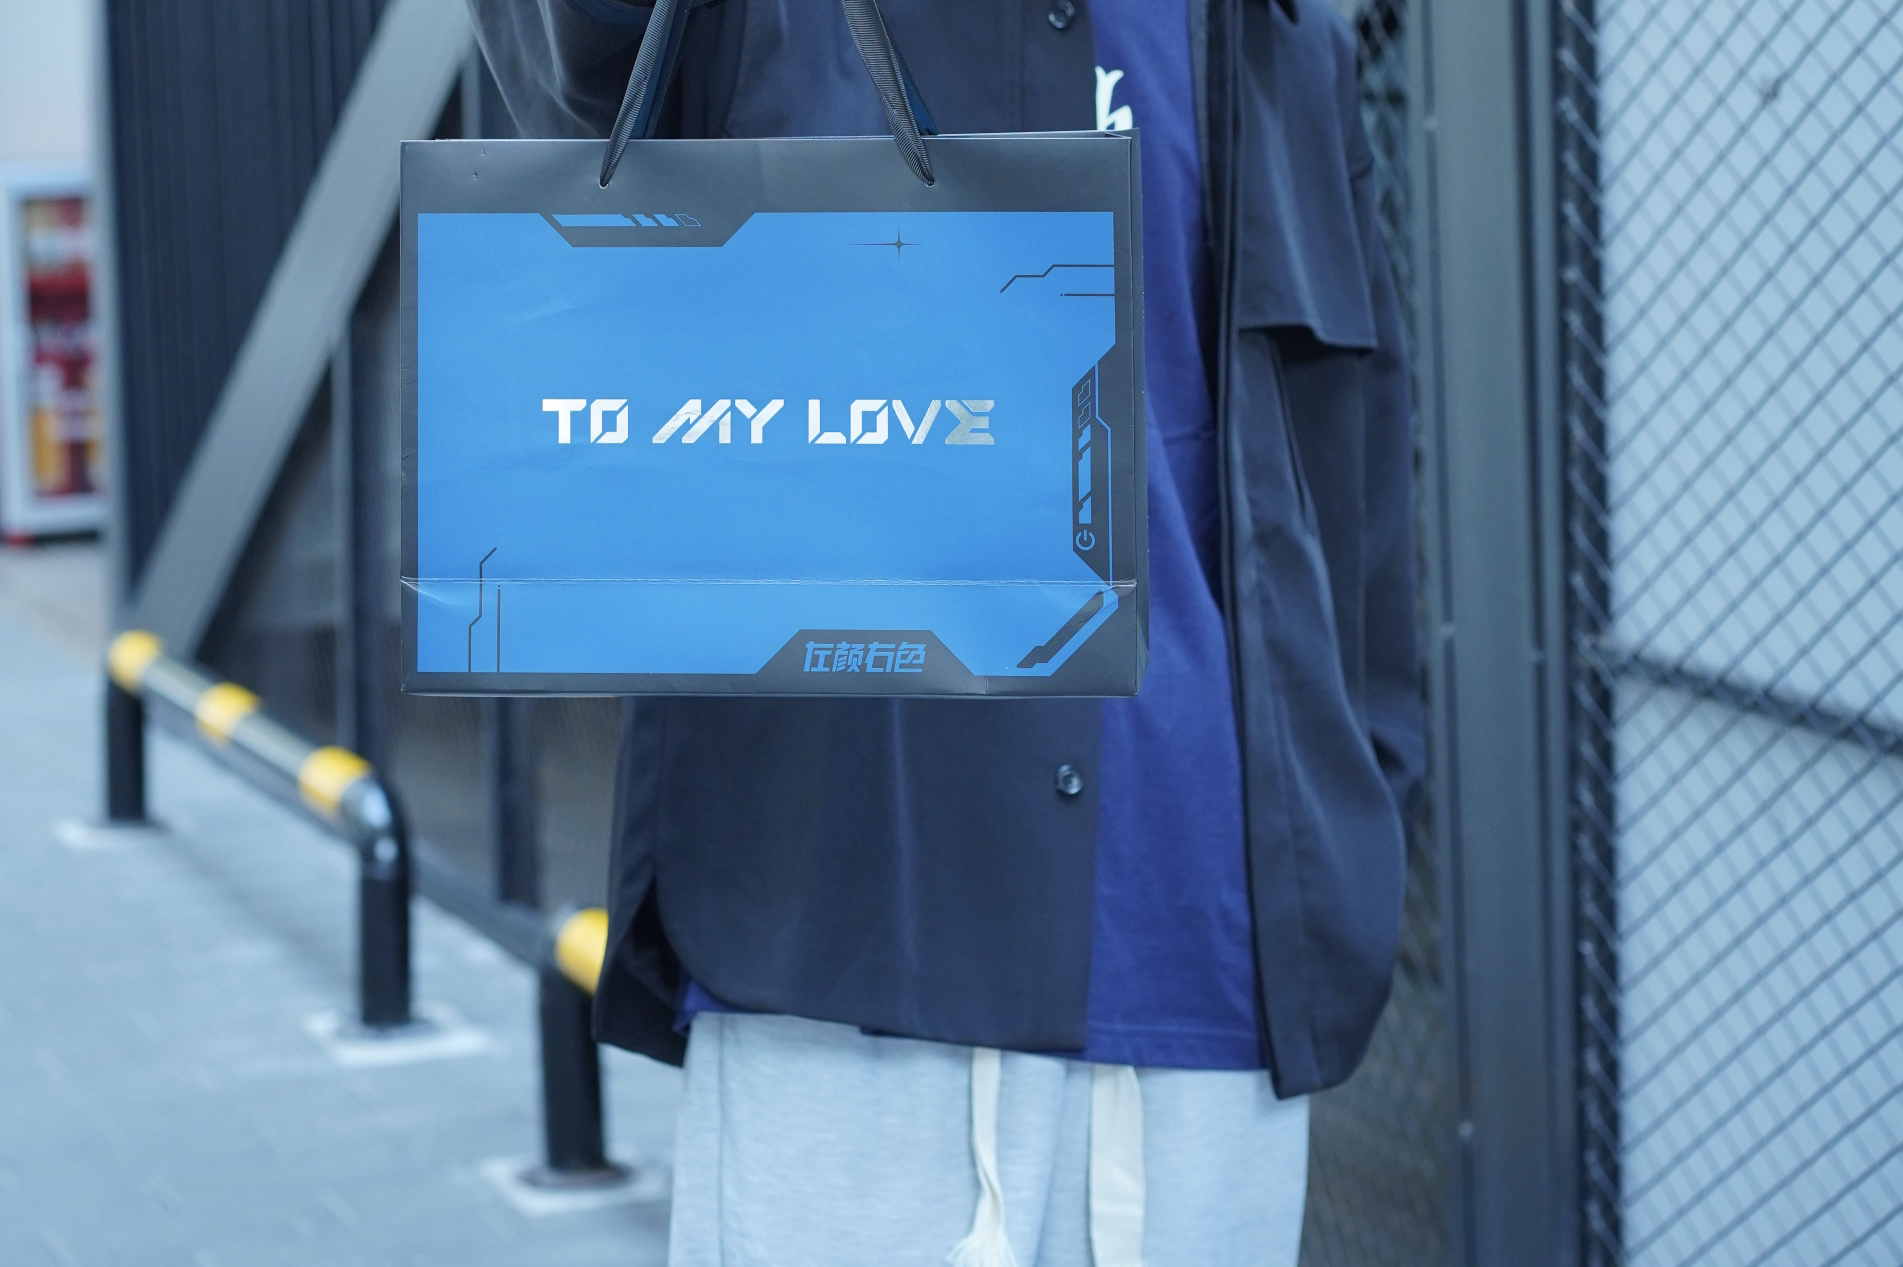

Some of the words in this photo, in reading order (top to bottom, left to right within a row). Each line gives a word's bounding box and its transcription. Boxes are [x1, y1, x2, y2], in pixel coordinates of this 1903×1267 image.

[542, 398, 629, 444] TO
[652, 398, 785, 444] MY
[808, 399, 995, 445] LOVE
[803, 640, 927, 673] 左颜右色
